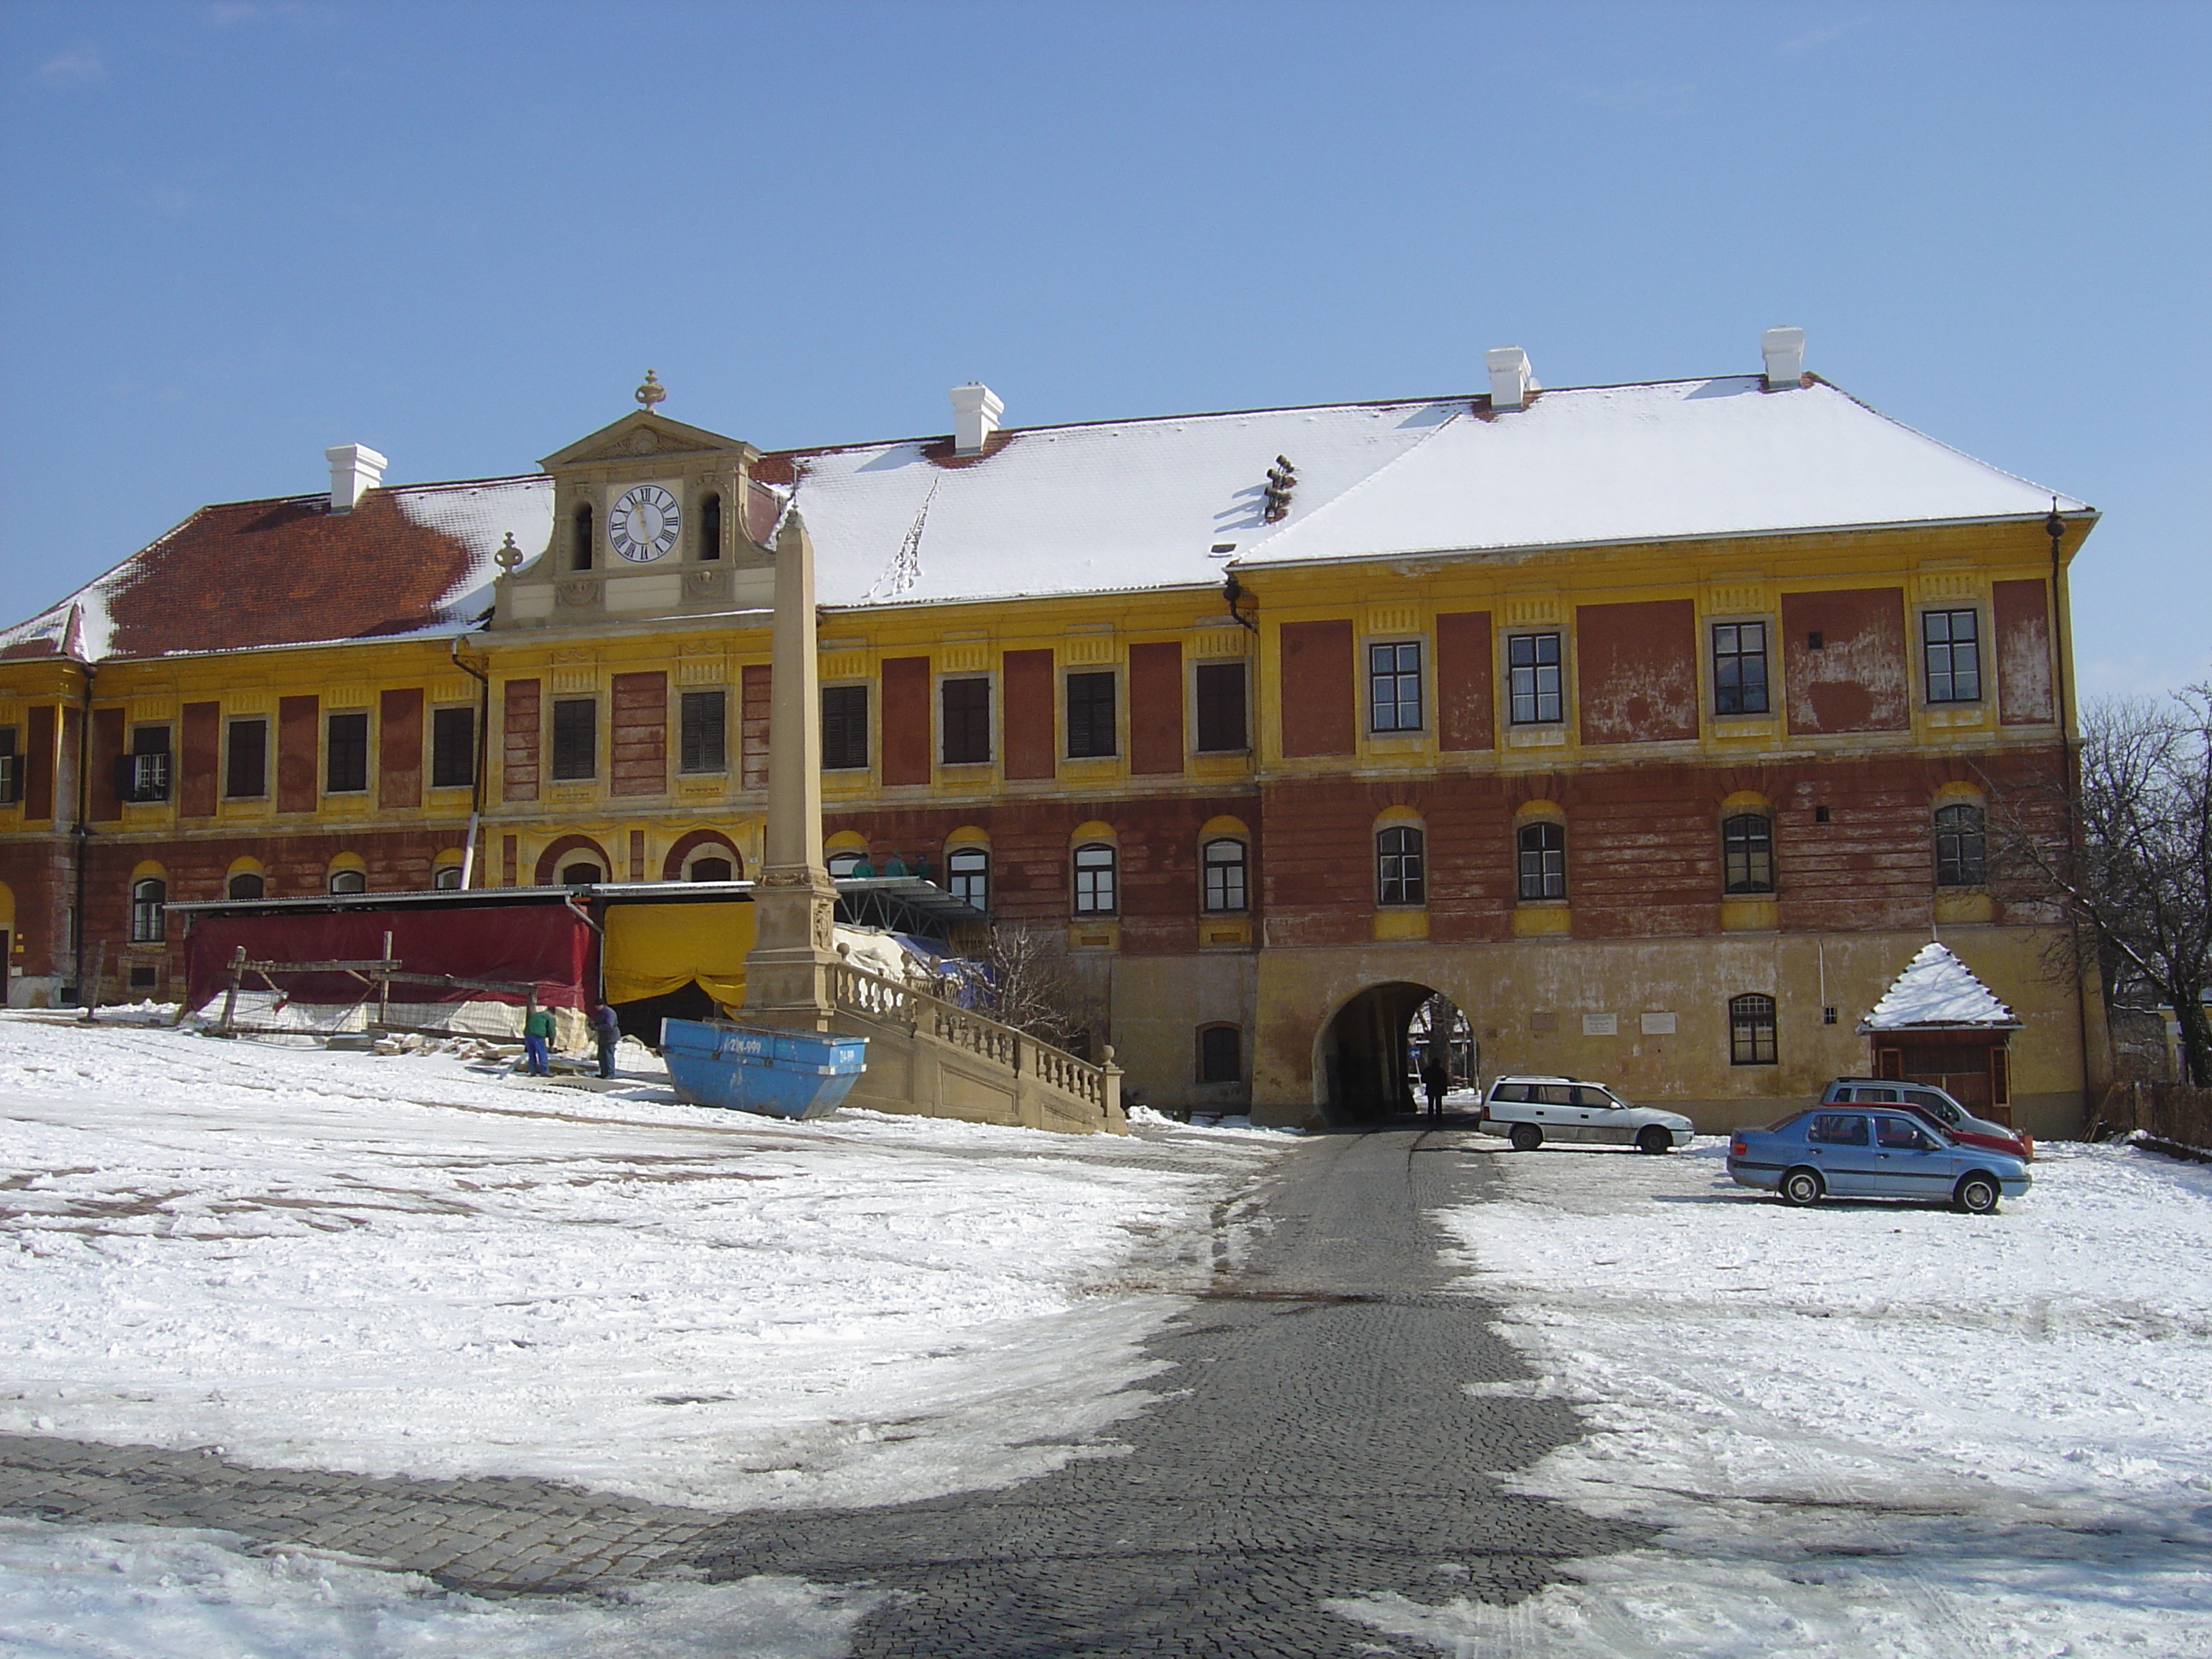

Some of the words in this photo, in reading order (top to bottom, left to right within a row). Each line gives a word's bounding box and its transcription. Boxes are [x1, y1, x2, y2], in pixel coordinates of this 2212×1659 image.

[626, 492, 637, 506] XI
[640, 488, 651, 502] XII
[655, 491, 663, 504] I
[614, 504, 628, 518] X
[661, 501, 675, 513] II
[612, 521, 625, 531] IX
[665, 516, 678, 526] III
[614, 533, 628, 549] VIII
[661, 529, 676, 544] IIII
[624, 542, 637, 558] VII
[640, 545, 649, 560] VI
[655, 542, 664, 556] V
